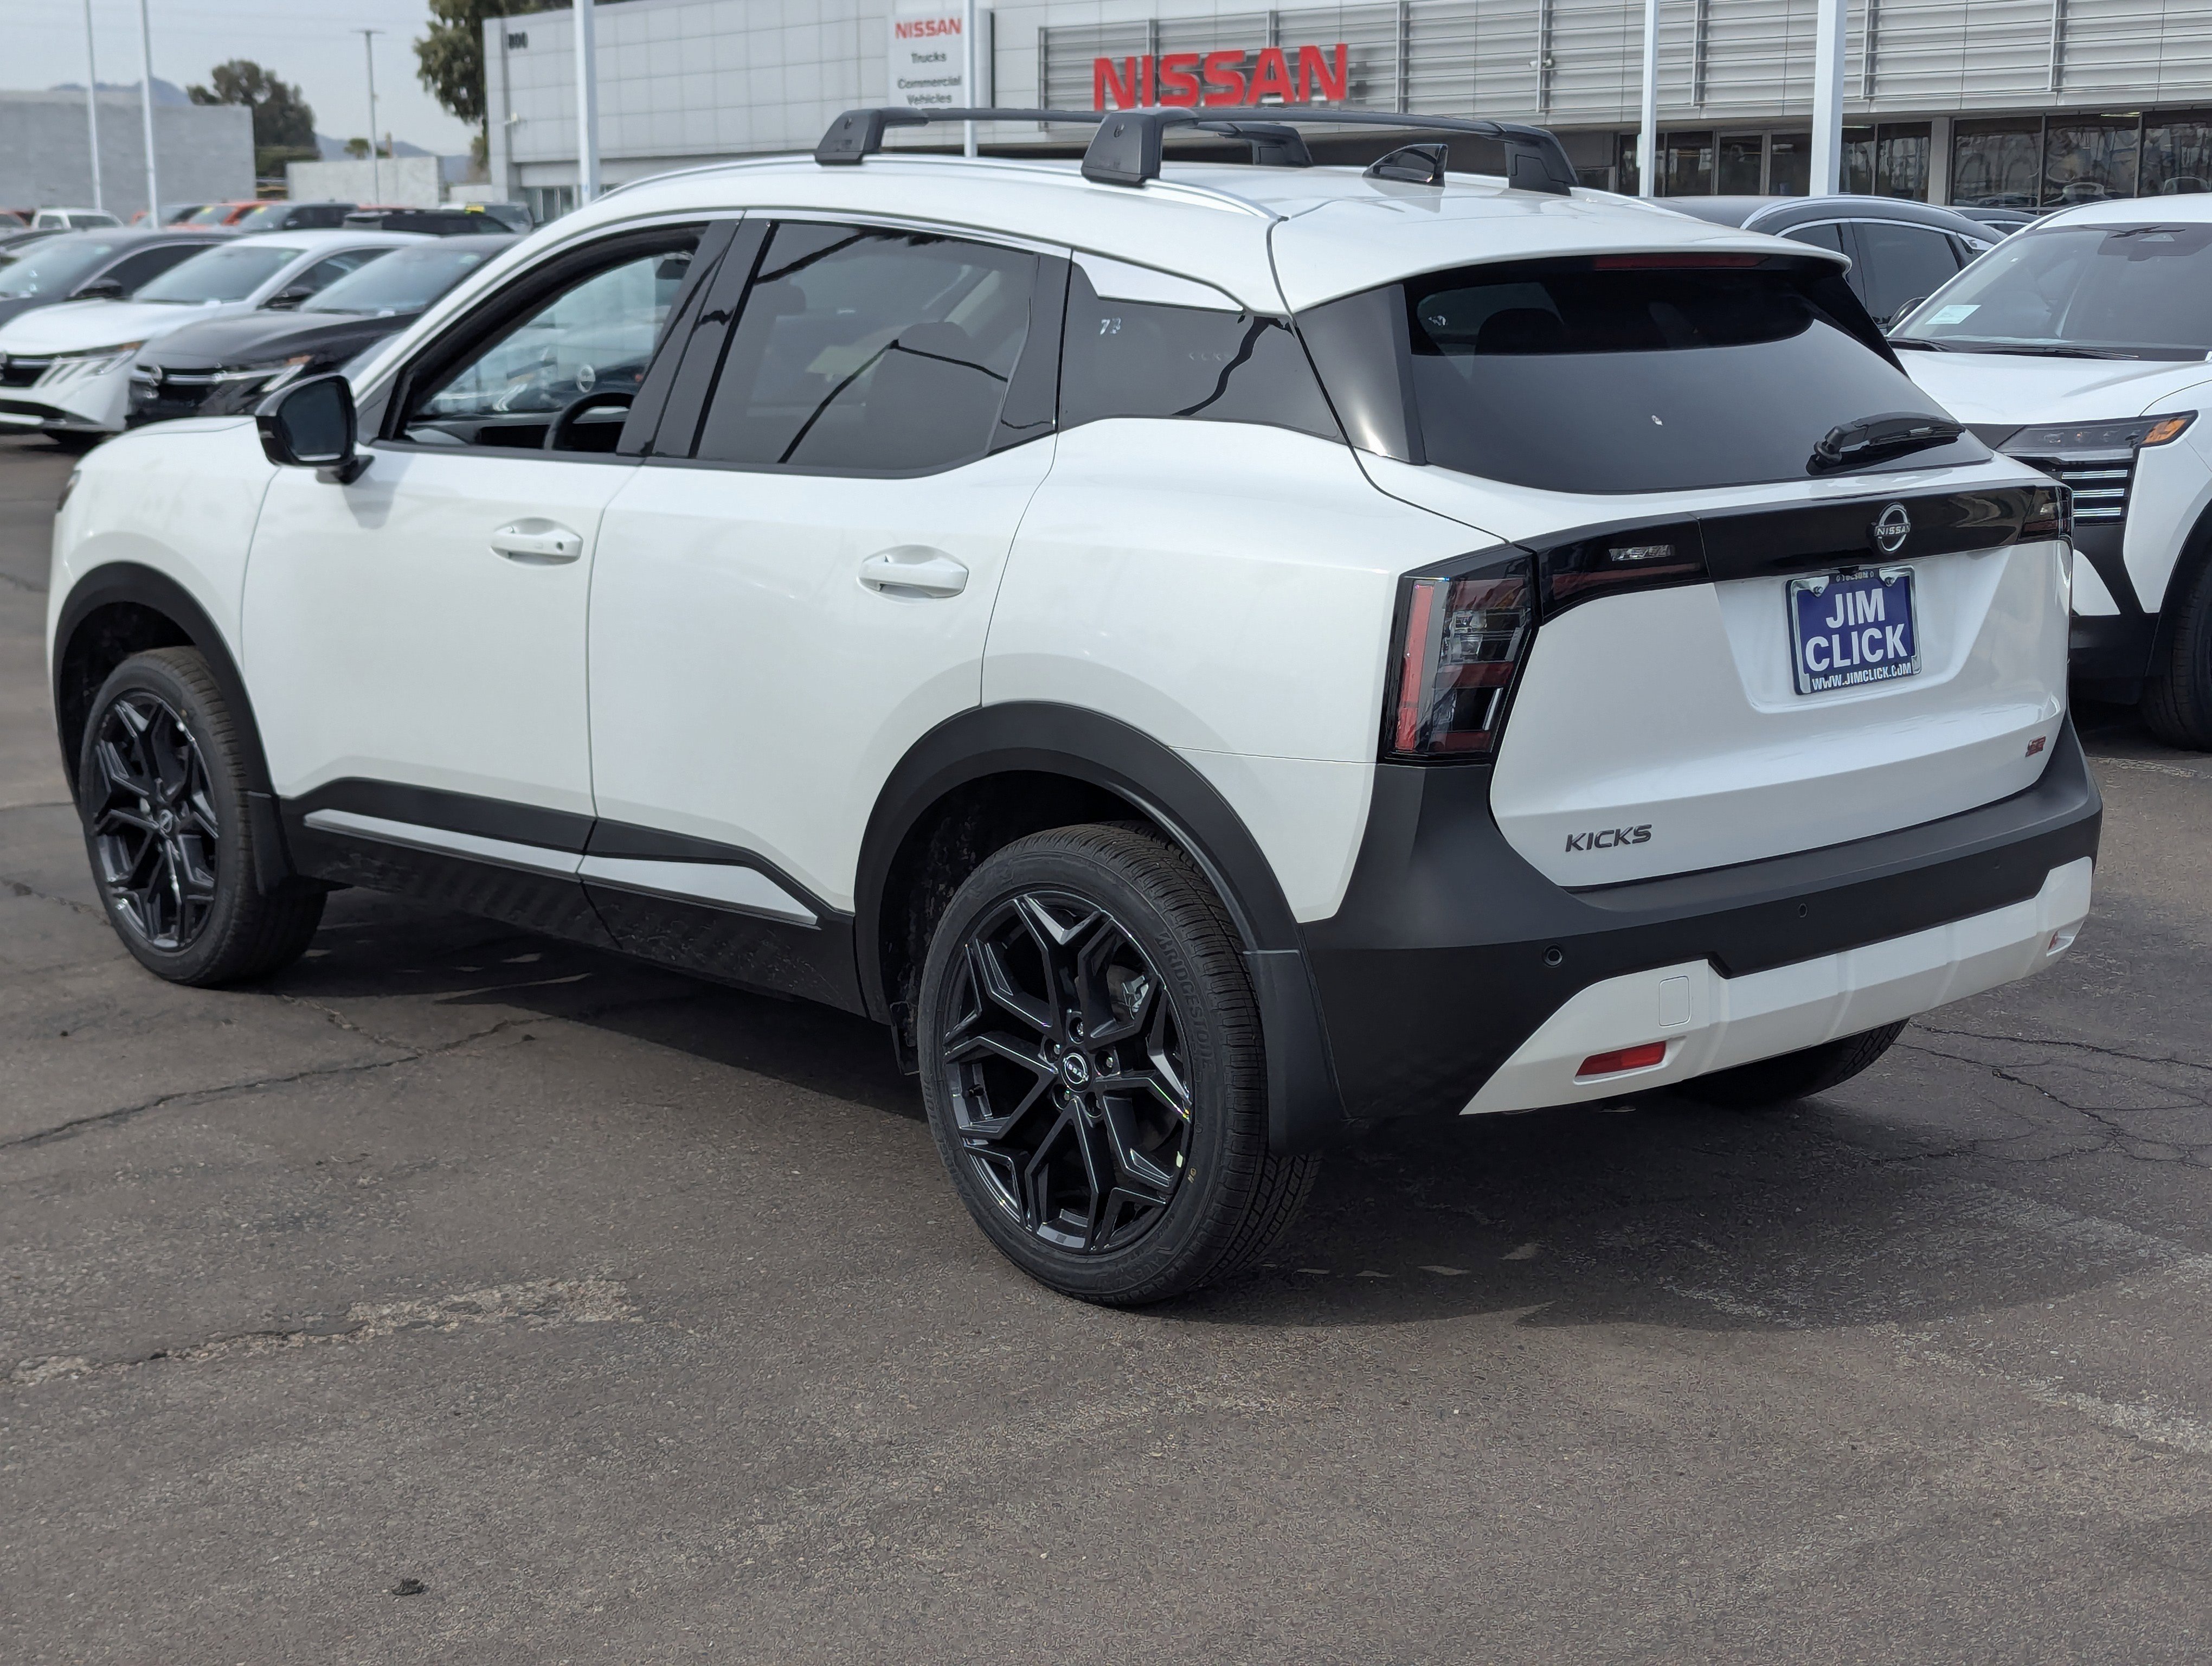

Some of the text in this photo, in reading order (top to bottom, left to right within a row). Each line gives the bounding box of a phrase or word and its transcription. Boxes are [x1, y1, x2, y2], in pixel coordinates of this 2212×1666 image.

[896, 18, 962, 39] NISSAN
[911, 52, 946, 63] Trucks
[897, 76, 962, 88] Commercial
[1094, 43, 1348, 112] NISSAN
[1876, 525, 1910, 535] NISSAN
[1826, 588, 1885, 628] JIM
[1805, 624, 1907, 671] CLICK
[1812, 662, 1912, 690] WWW.JIMCLICK.COM
[1565, 824, 1652, 853] KICKS
